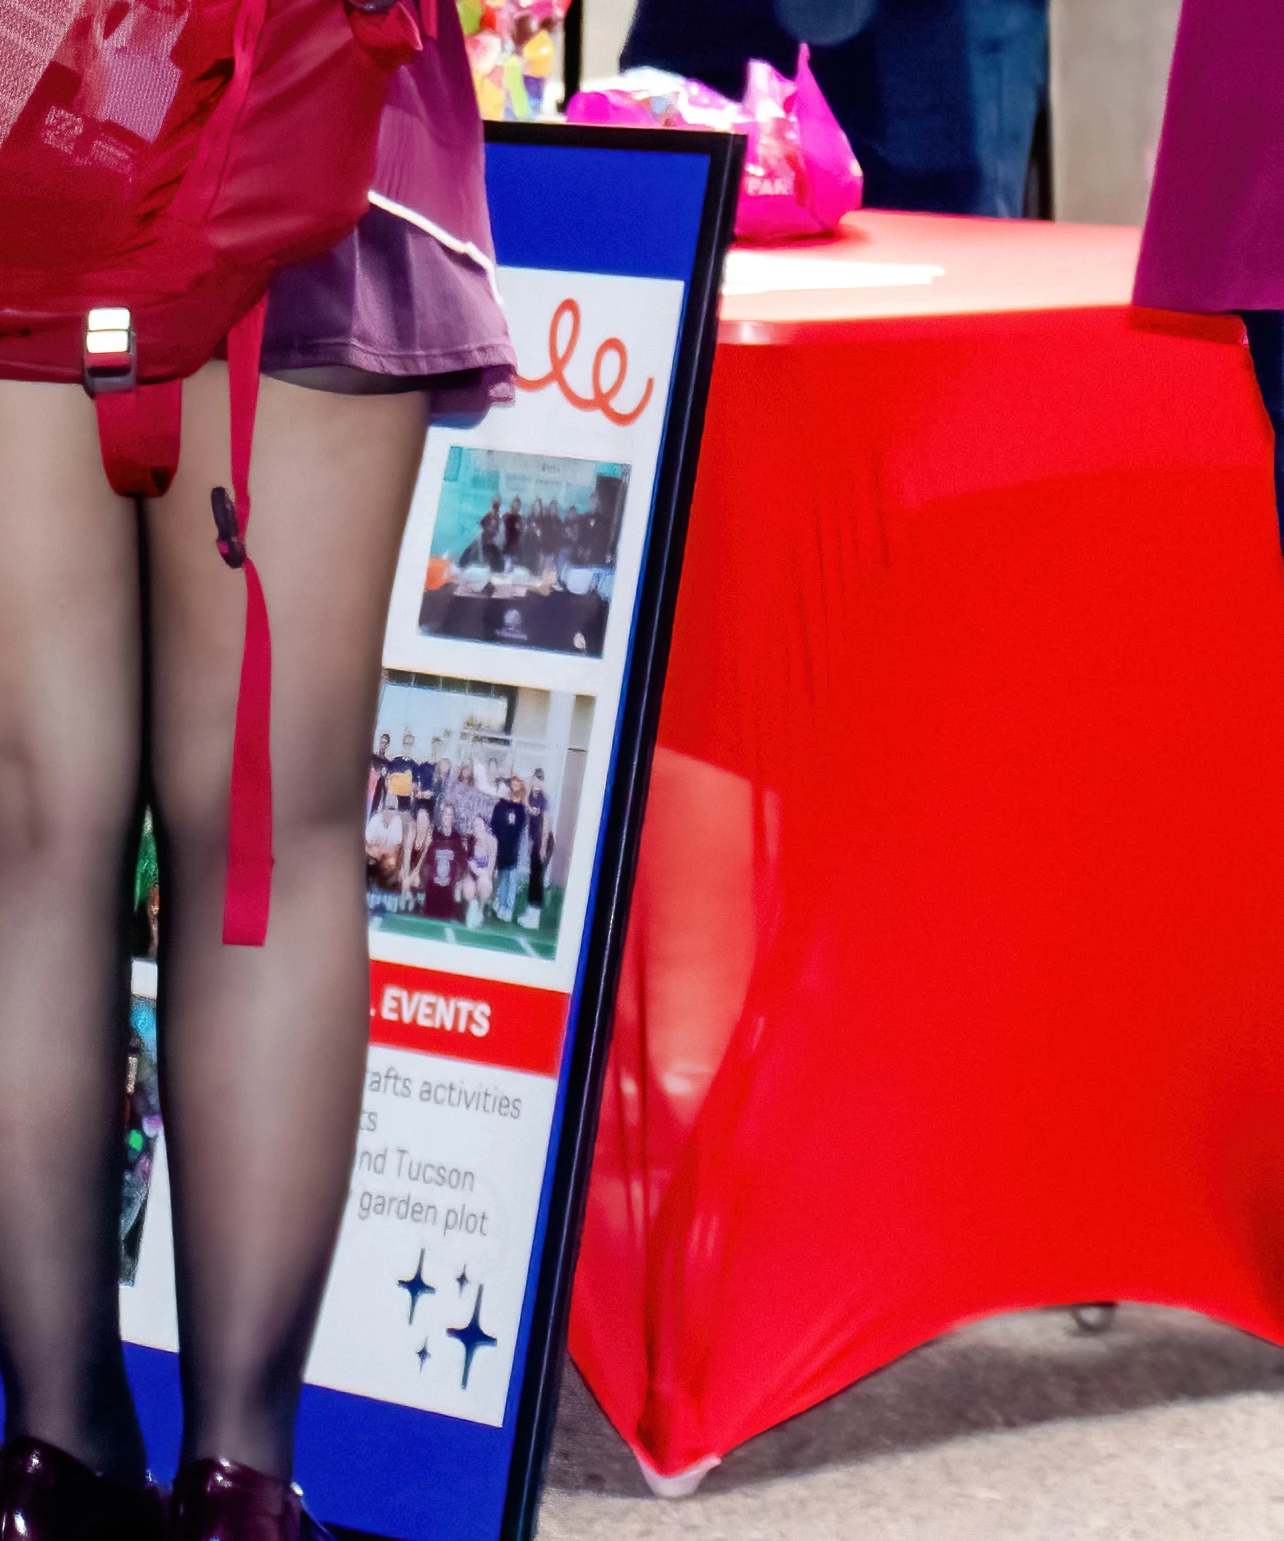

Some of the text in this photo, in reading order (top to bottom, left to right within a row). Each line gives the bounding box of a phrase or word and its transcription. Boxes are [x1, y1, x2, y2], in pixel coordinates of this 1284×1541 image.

[381, 985, 491, 1037] EVENTS
[367, 1066, 523, 1120] afts activities
[395, 1147, 475, 1191] Tucson
[358, 1190, 488, 1237] garden plot
